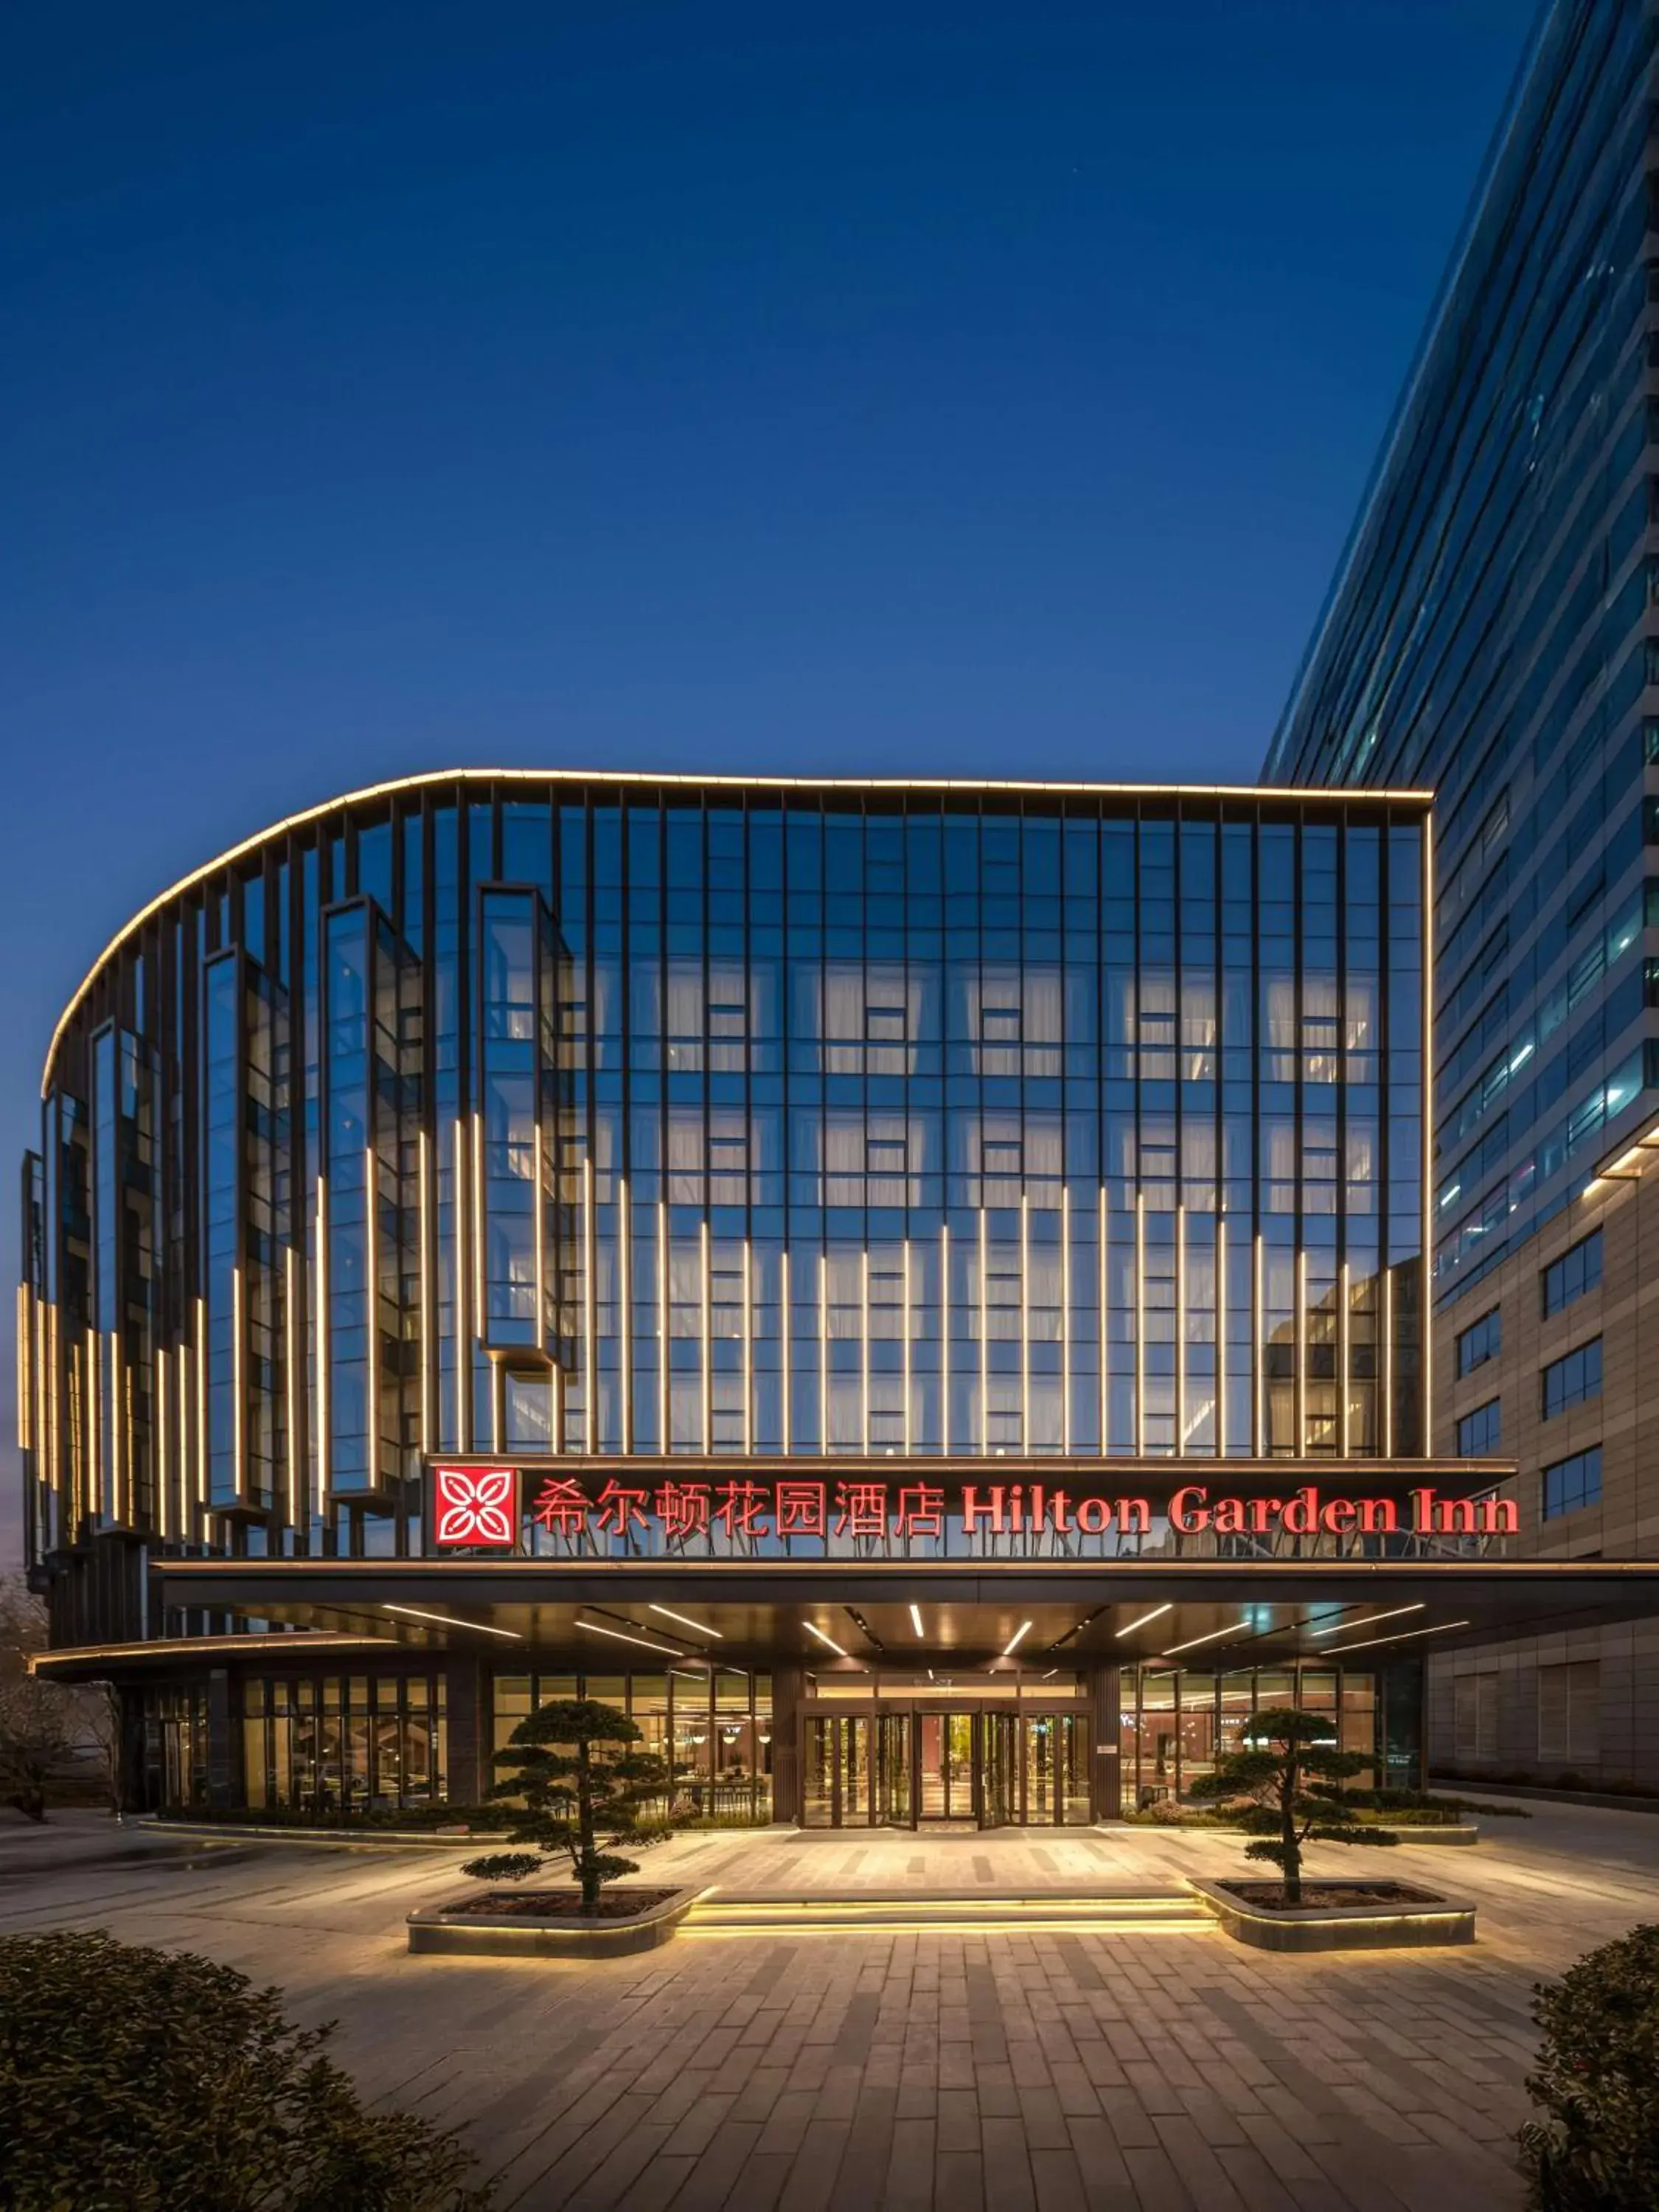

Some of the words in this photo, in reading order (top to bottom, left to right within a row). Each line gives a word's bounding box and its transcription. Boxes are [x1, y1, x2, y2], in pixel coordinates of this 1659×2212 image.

[532, 1478, 945, 1538] 希尔顿花园酒店
[961, 1485, 1151, 1534] Hilton
[1169, 1486, 1398, 1534] Garden
[1415, 1488, 1520, 1534] Inn
